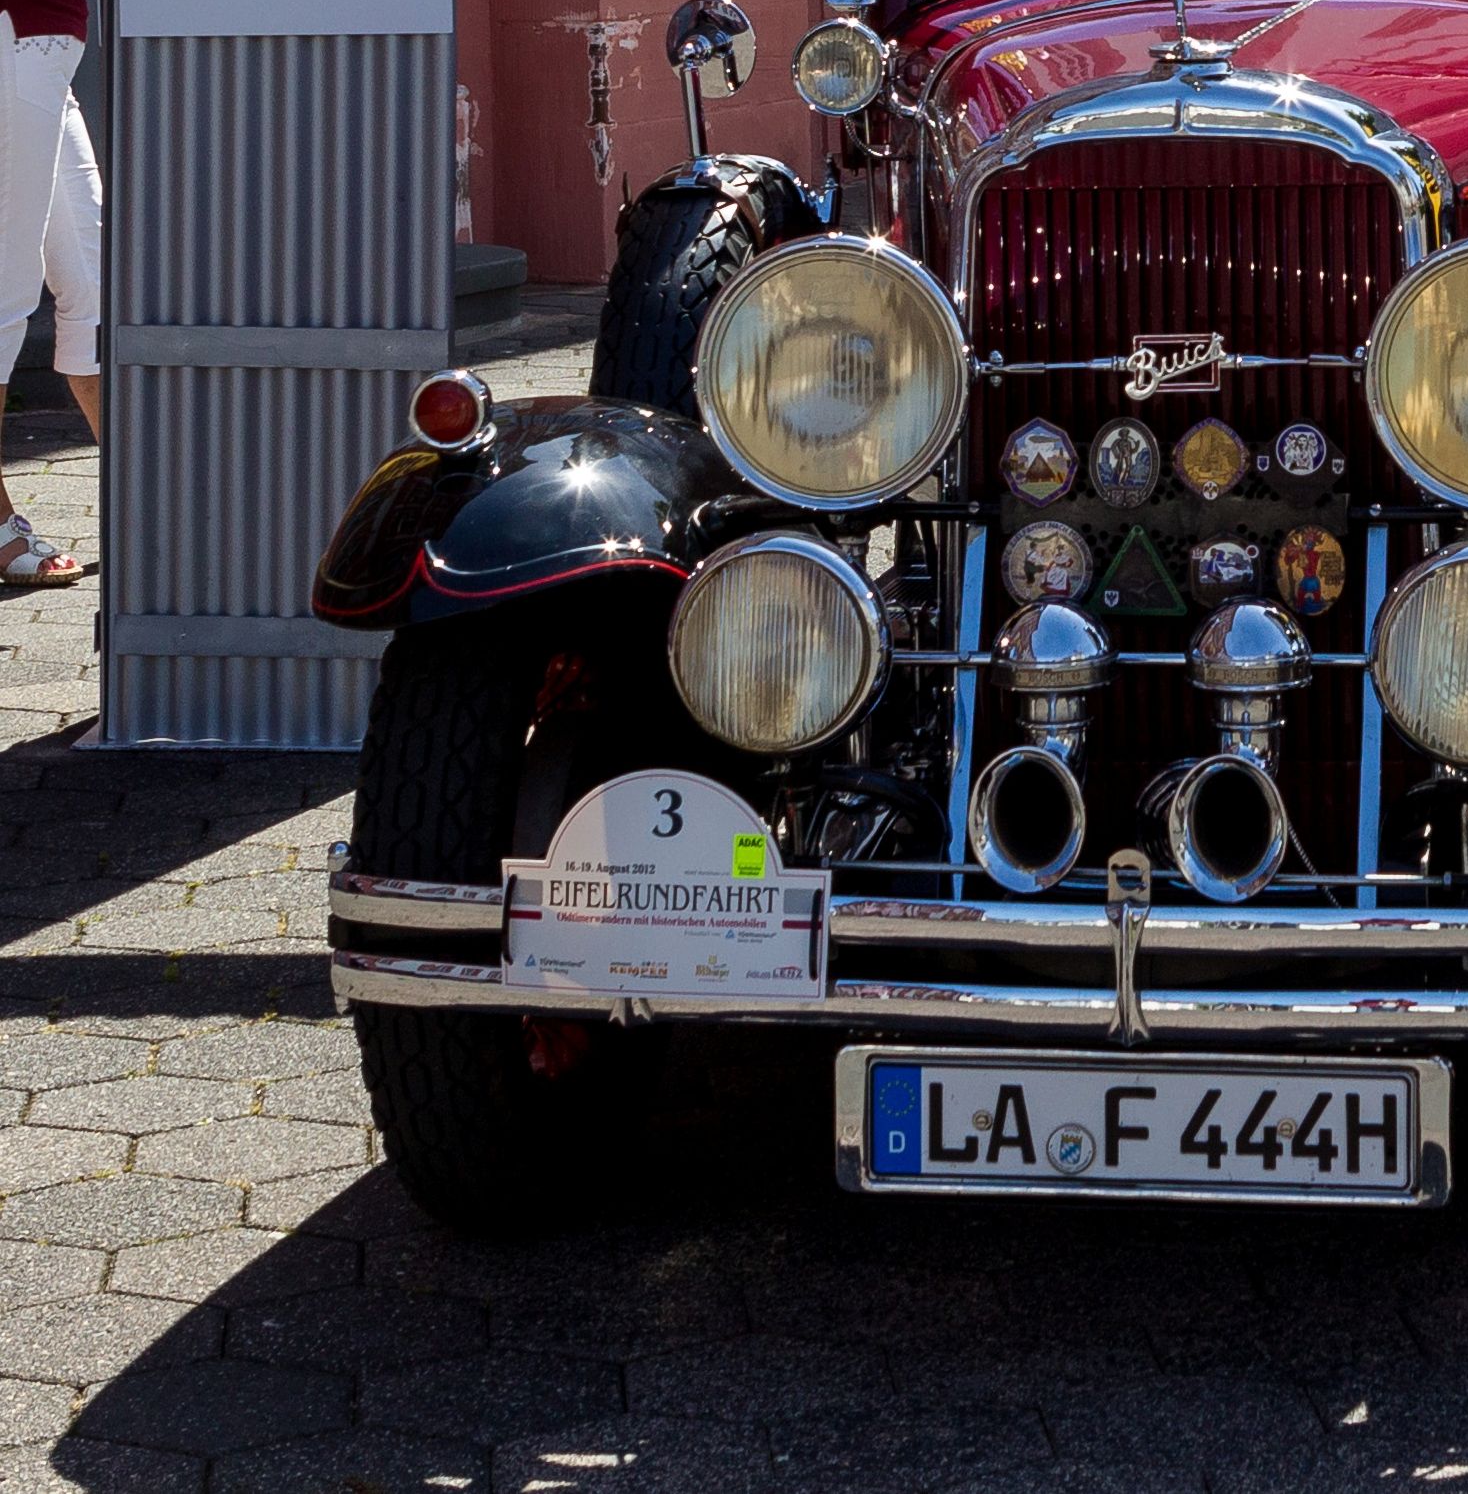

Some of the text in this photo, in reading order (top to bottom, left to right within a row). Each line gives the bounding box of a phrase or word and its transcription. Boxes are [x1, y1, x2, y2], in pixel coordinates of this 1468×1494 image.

[1125, 332, 1226, 400] Buick
[652, 788, 683, 838] 3
[738, 838, 763, 847] ADAC
[596, 862, 630, 875] August
[632, 864, 656, 875] 2012
[549, 880, 779, 914] EIFELRUNDFAHRT
[556, 911, 767, 929] Oldtimerwandern mit historischen Automobilen
[888, 1130, 906, 1154] D
[928, 1082, 1036, 1165] LA
[1104, 1086, 1157, 1168] F
[1180, 1088, 1398, 1175] 444H
